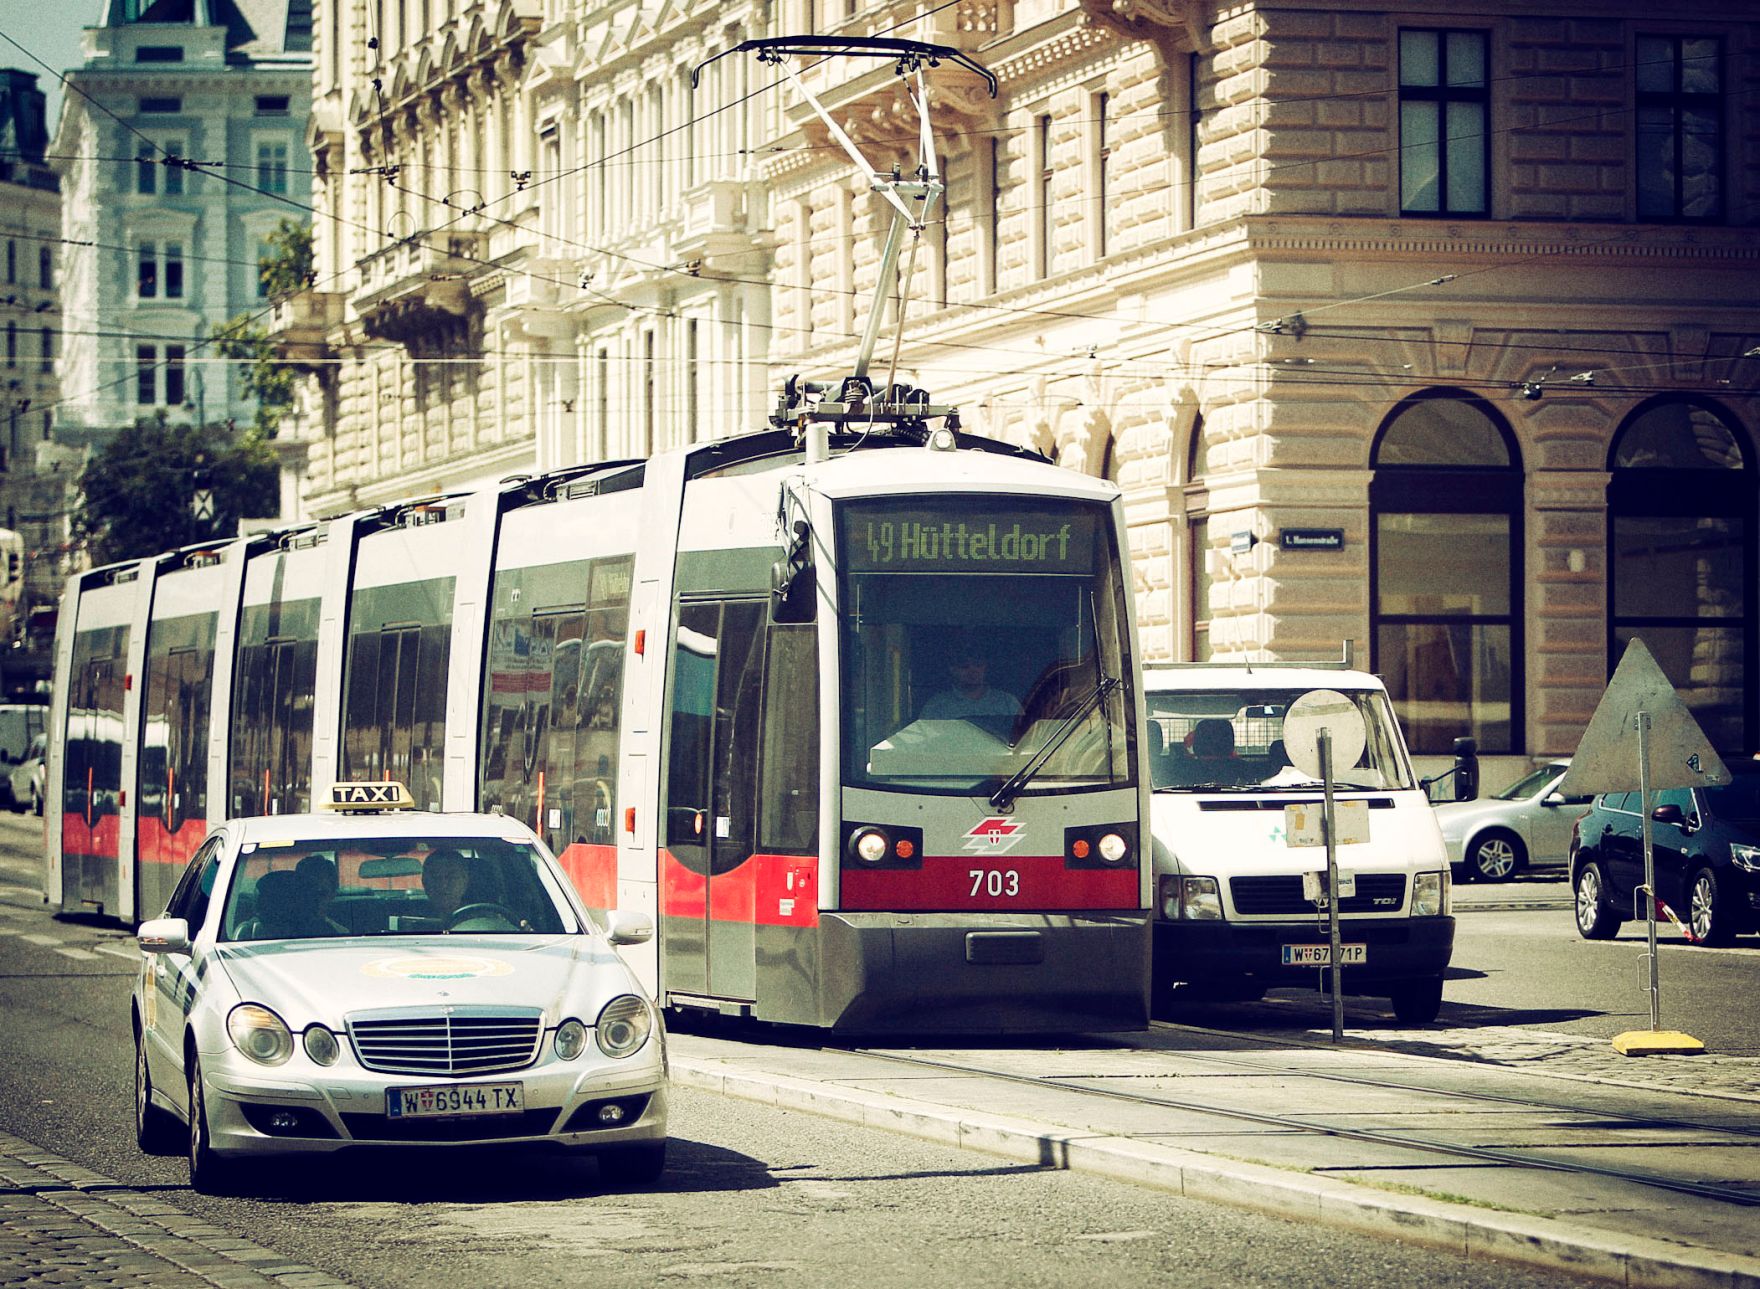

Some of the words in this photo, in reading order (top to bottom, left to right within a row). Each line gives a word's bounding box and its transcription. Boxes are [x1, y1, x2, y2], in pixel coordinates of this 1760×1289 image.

[867, 522, 894, 562] 49
[901, 522, 1071, 561] Hütteldorf
[333, 786, 399, 802] TAXI
[969, 869, 1019, 897] 703
[1294, 948, 1304, 961] W
[404, 1092, 418, 1113] W
[436, 1090, 487, 1112] 6944
